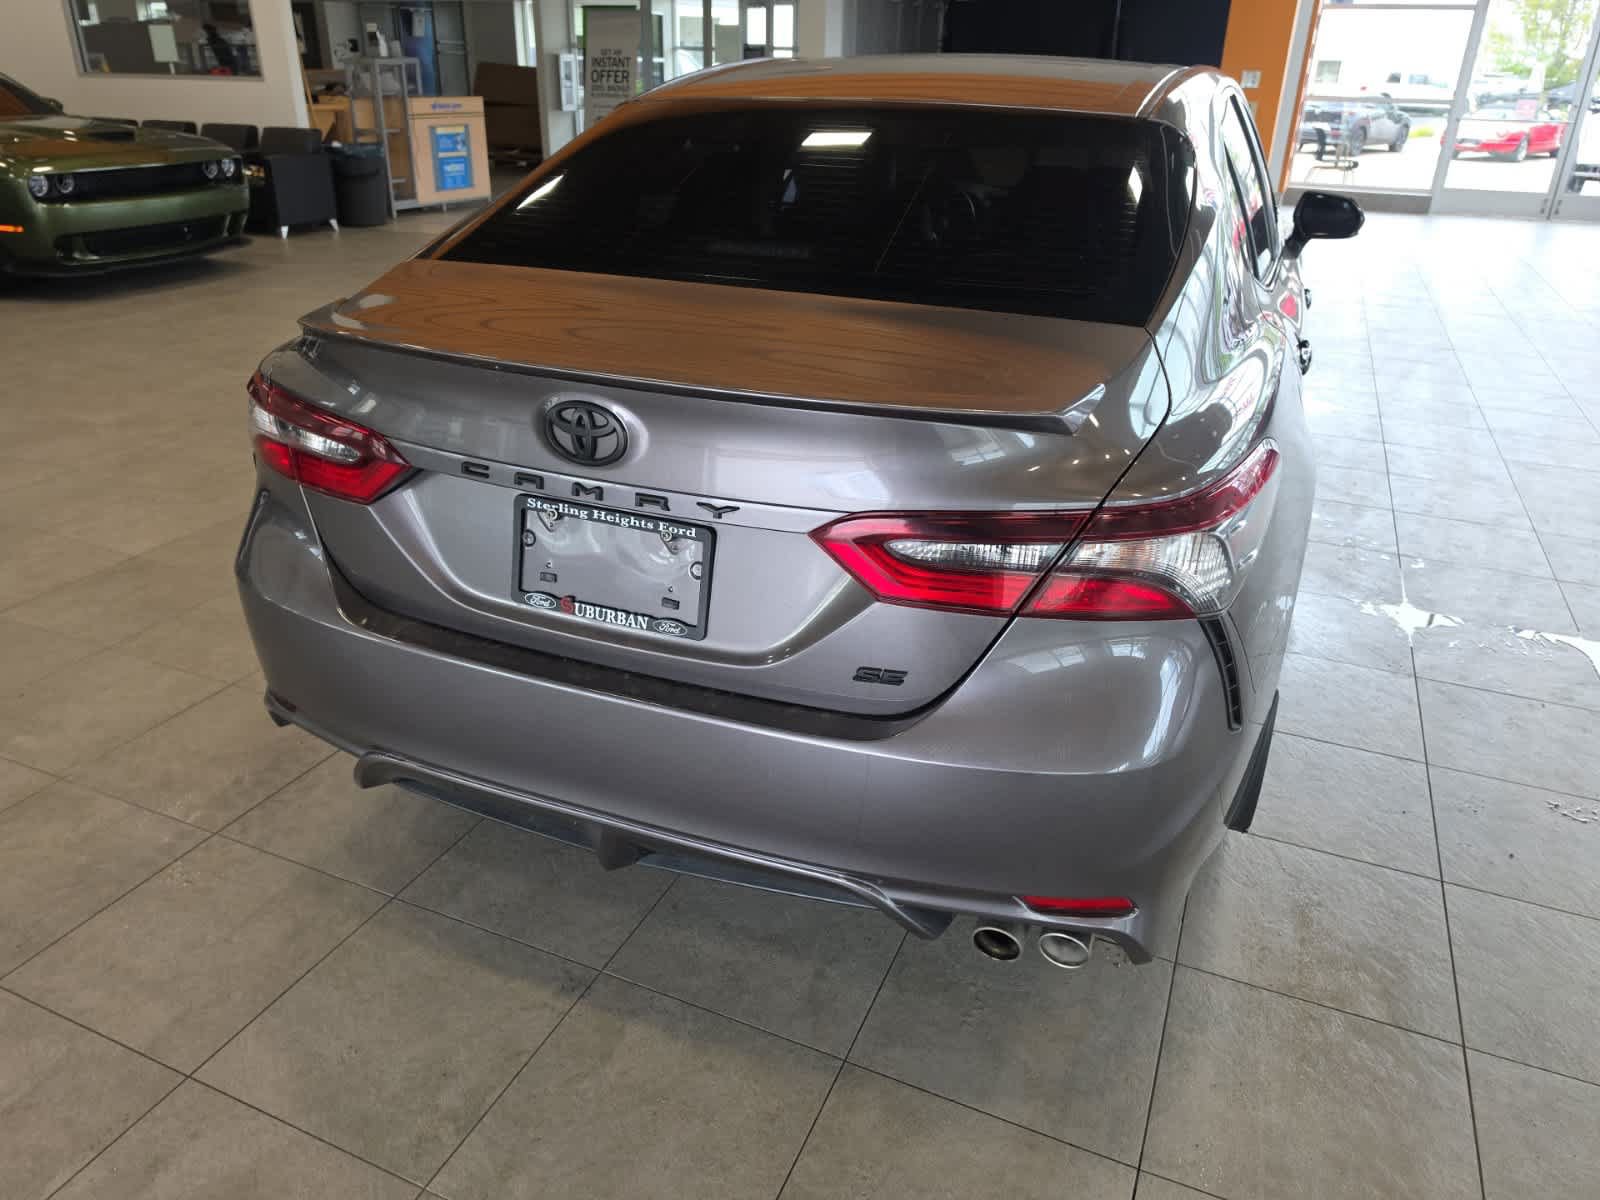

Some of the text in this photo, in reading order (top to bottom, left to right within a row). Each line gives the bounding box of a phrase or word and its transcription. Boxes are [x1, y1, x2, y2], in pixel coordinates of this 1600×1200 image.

[592, 57, 631, 67] INSTANT
[591, 70, 630, 83] OFFER
[461, 461, 740, 519] CAMRY
[527, 498, 697, 538] Sterling Heights Ford
[560, 595, 649, 630] SUBURBAN
[852, 666, 908, 686] SE
